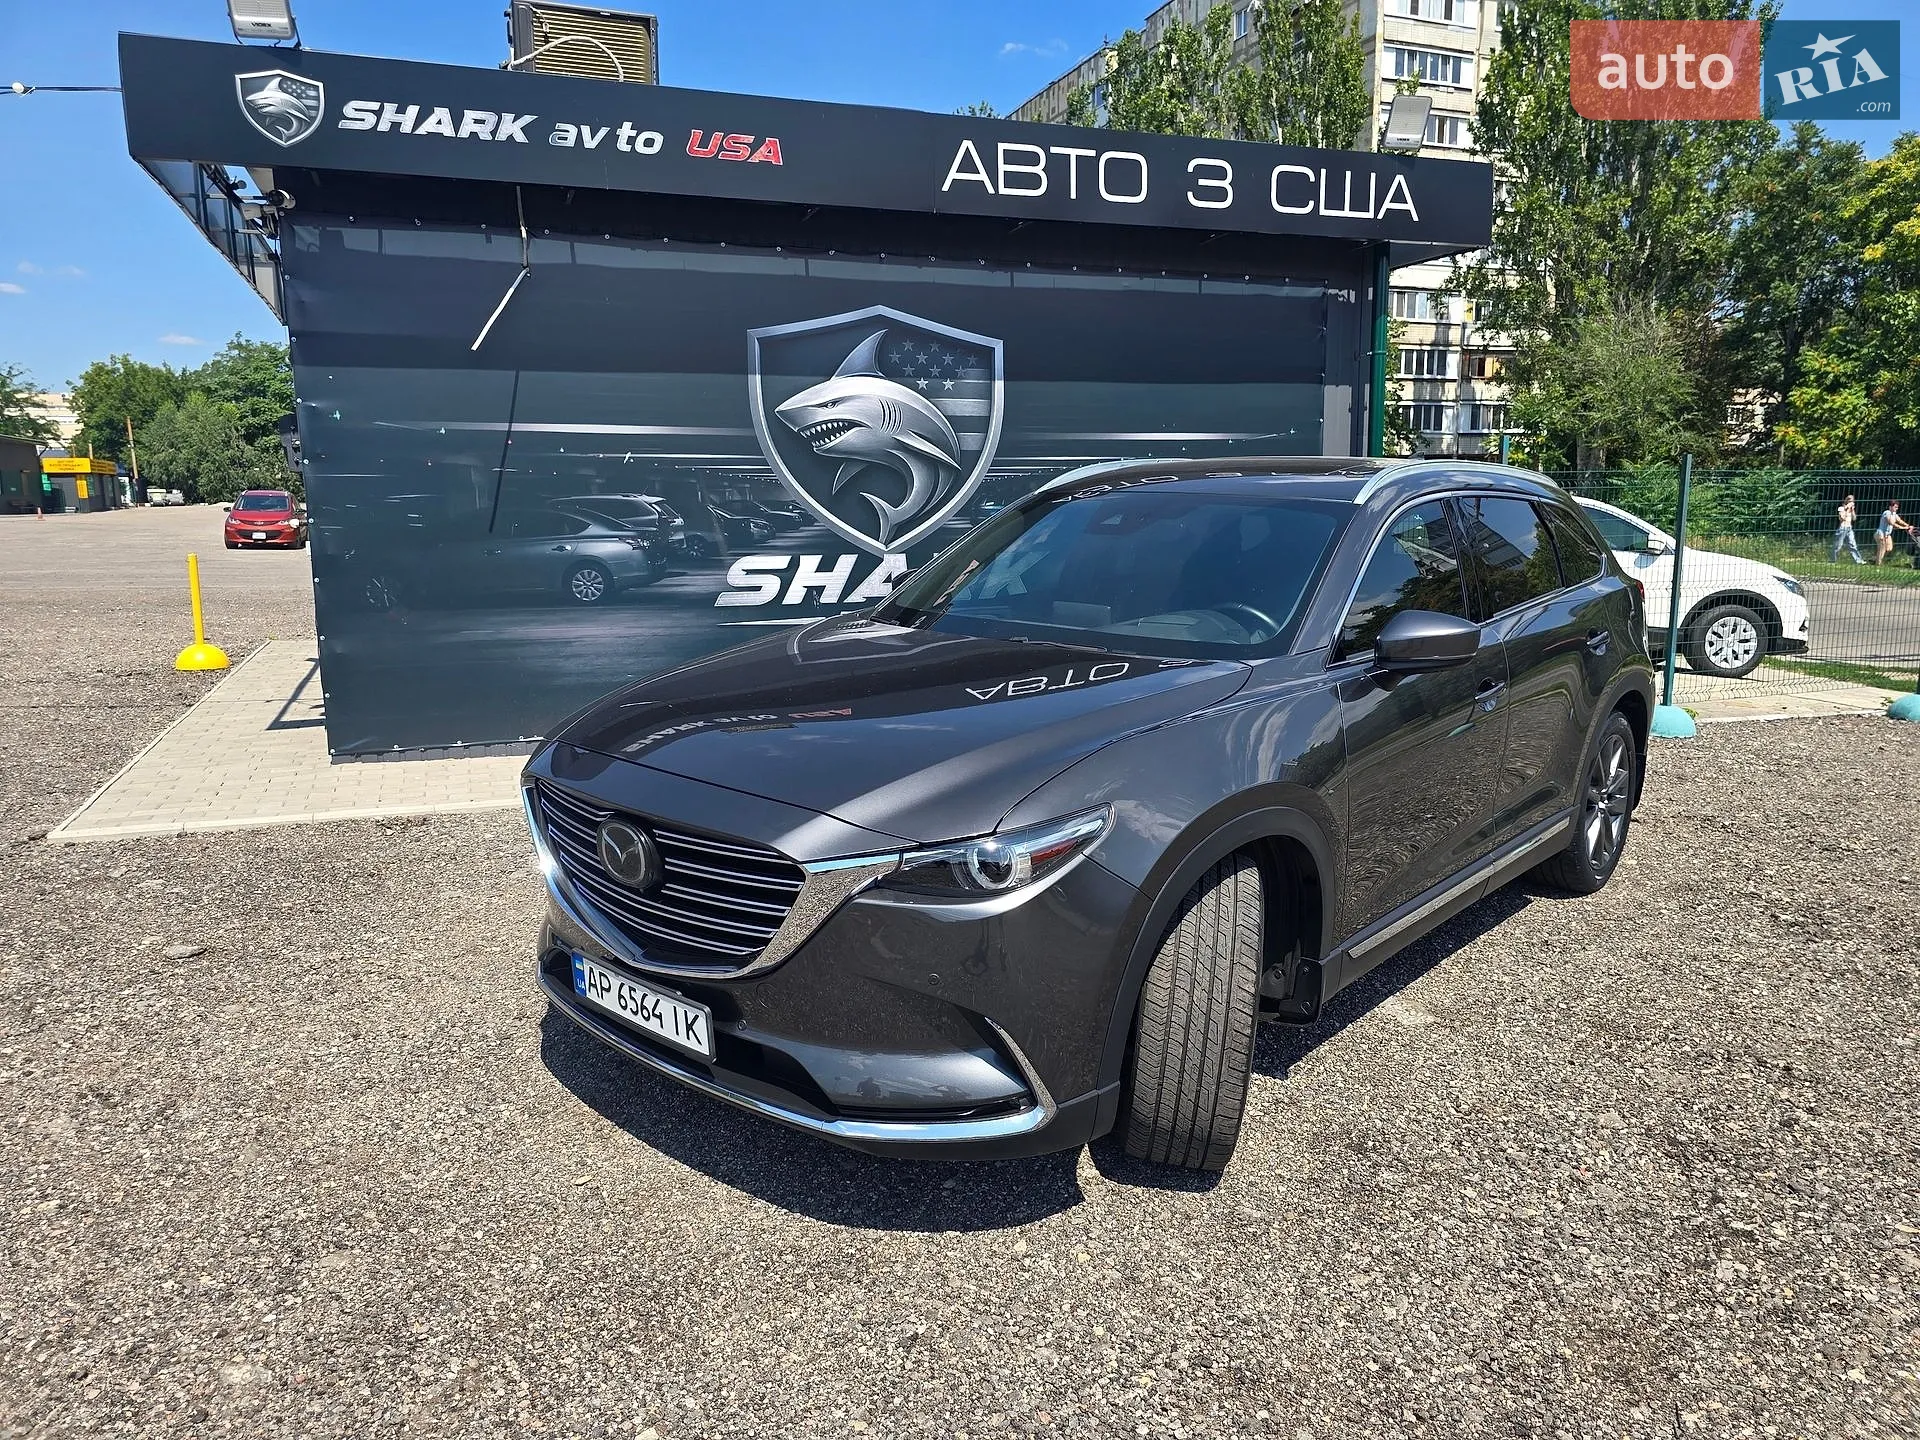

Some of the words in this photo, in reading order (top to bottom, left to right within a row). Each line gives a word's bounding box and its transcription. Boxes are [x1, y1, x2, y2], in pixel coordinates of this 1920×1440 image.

[338, 100, 539, 144] SHARK
[686, 129, 784, 166] USA
[941, 138, 1149, 204] АВТО
[1270, 164, 1420, 222] США
[588, 966, 612, 1001] AP
[617, 982, 664, 1030] 6564
[673, 1005, 703, 1046] IK
